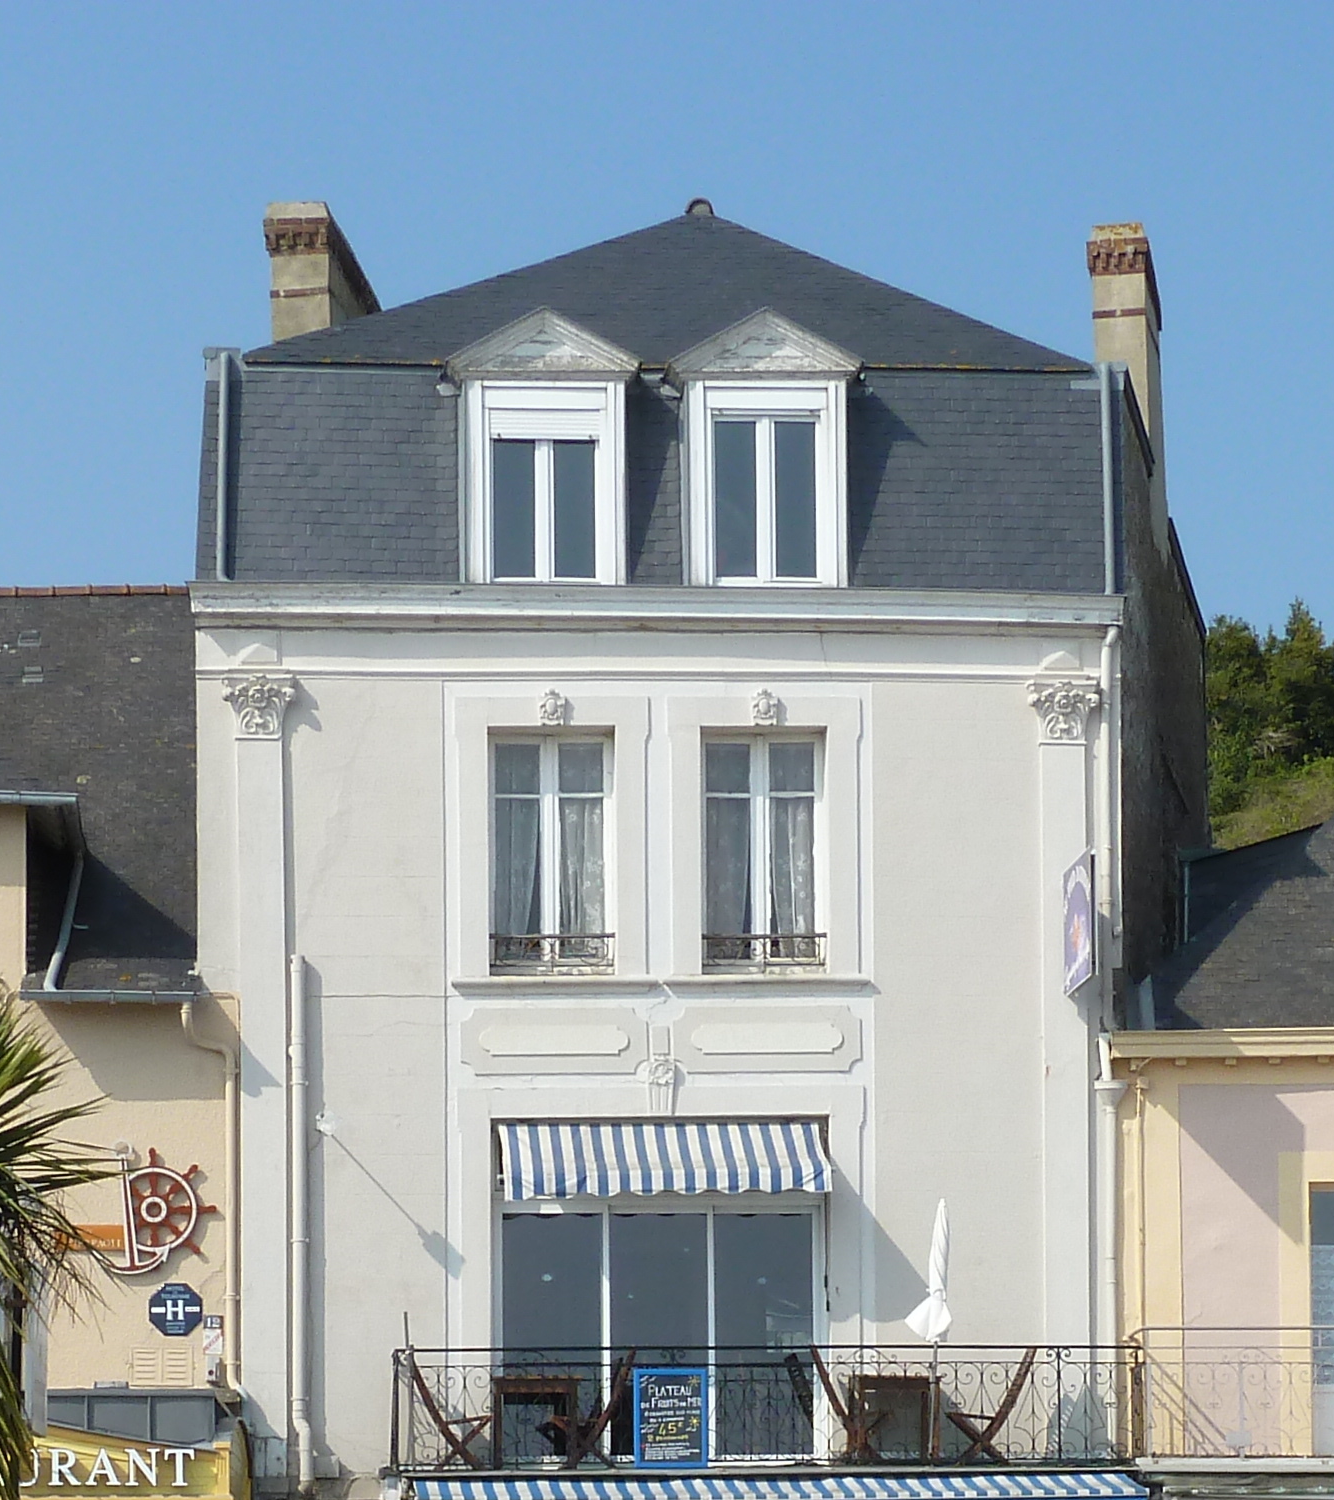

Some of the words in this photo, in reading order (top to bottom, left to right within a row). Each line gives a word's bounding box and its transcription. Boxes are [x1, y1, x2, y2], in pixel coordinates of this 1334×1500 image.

[166, 1300, 184, 1320] H
[648, 1384, 692, 1397] PLATEAU
[652, 1397, 679, 1408] FRUITS
[687, 1397, 702, 1408] MER
